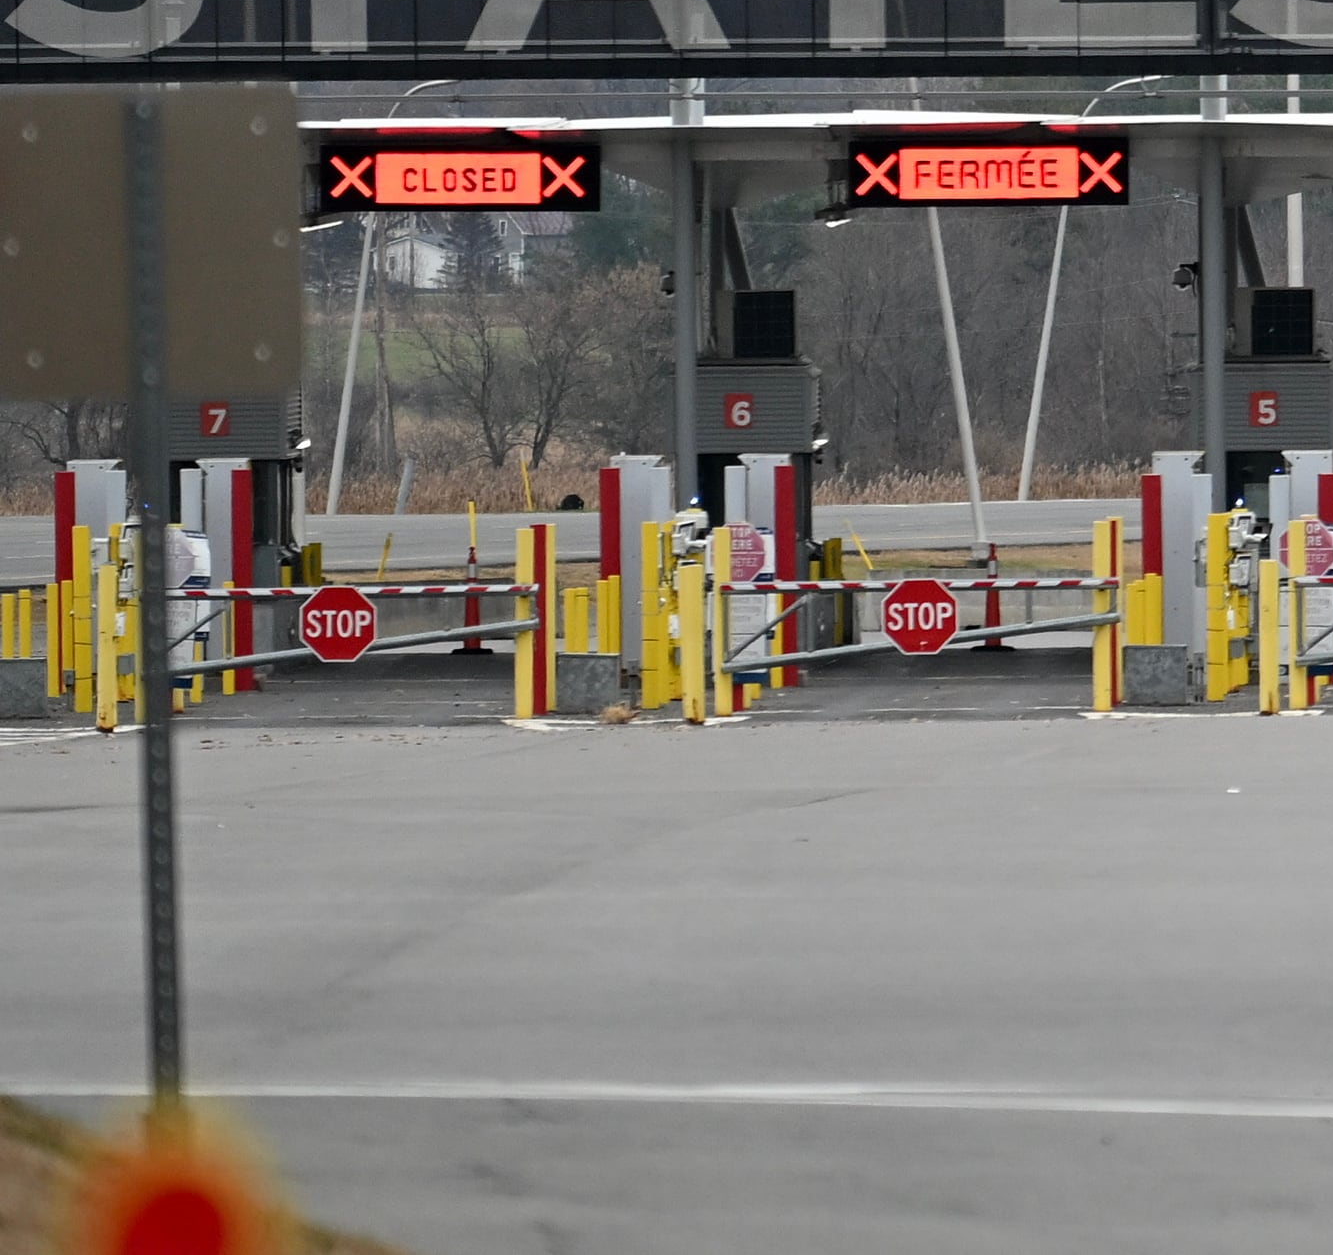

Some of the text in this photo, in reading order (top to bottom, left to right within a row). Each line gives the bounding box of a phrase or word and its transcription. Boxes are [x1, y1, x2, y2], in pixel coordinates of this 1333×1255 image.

[403, 167, 517, 193] CLOSED
[914, 151, 1059, 190] FERMÉE
[209, 408, 228, 436] 7
[731, 401, 751, 427] 6
[1258, 398, 1277, 423] 5
[731, 527, 752, 538] TOP
[731, 539, 753, 550] ERE
[305, 608, 372, 640] STOP
[886, 602, 956, 632] STOP
